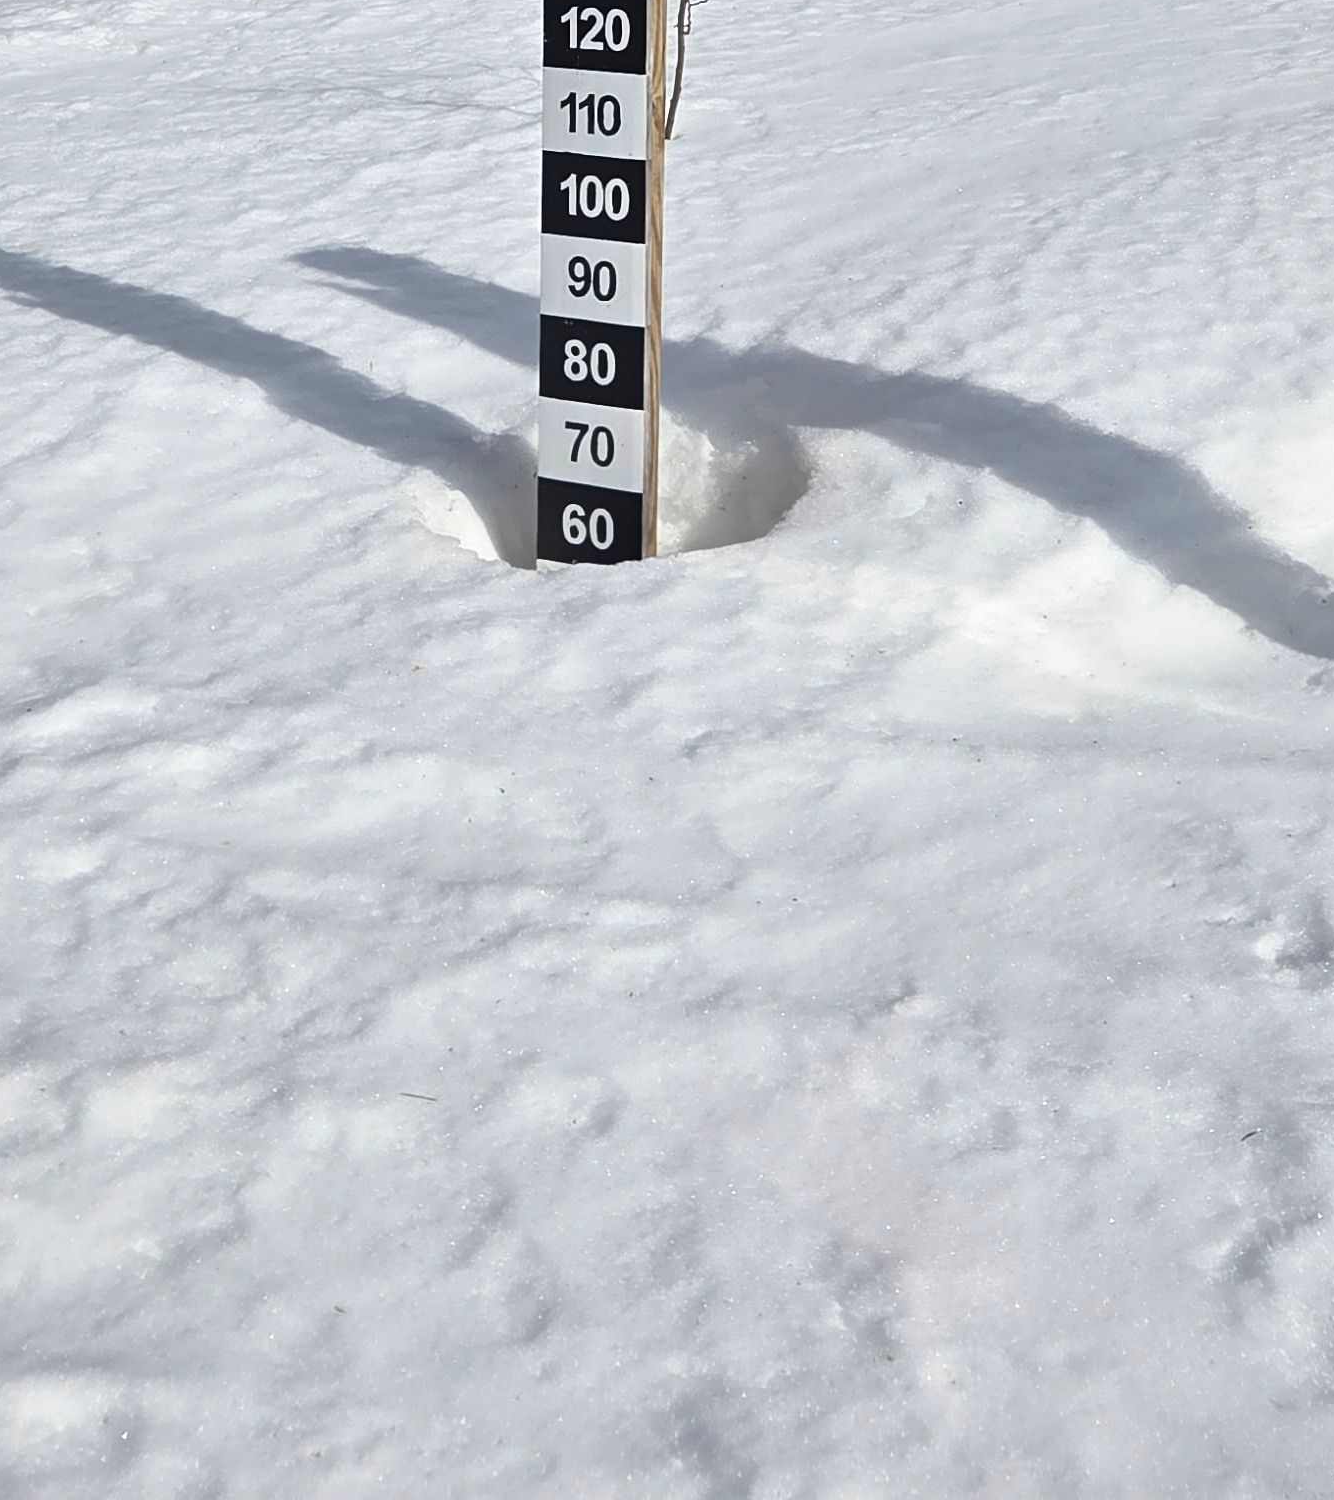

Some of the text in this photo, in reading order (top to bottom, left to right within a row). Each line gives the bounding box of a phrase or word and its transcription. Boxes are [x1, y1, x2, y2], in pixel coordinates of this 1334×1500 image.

[560, 6, 631, 52] 120
[560, 92, 621, 136] 110
[560, 173, 630, 221] 100
[568, 256, 617, 301] 90
[563, 339, 616, 386] 80
[564, 421, 615, 467] 70
[562, 504, 614, 550] 60
